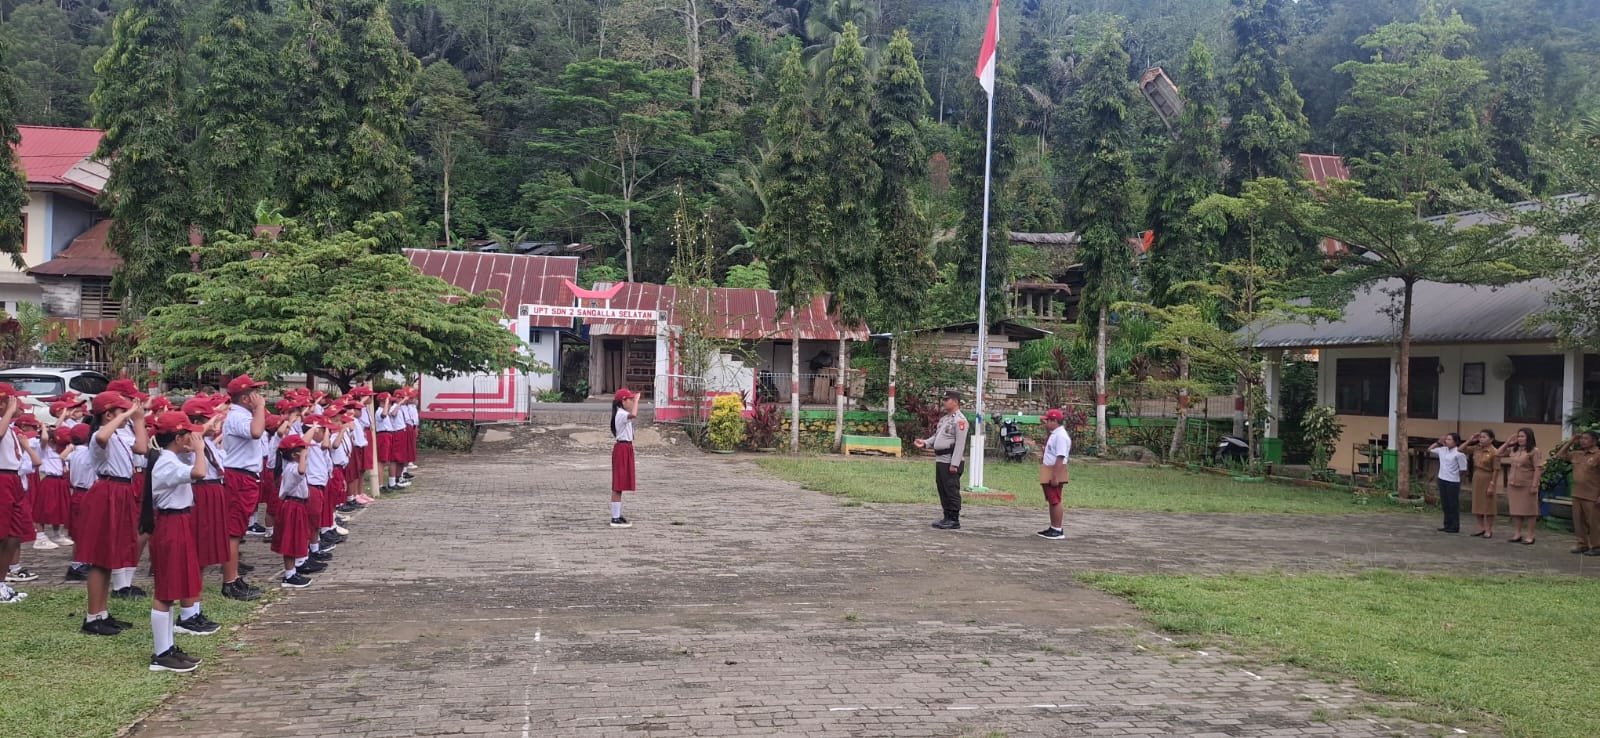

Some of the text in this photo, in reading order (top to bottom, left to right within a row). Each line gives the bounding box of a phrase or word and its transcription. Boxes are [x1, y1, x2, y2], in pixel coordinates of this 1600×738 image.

[533, 306, 549, 314] UPT
[551, 307, 566, 315] SDN
[618, 310, 652, 318] SELATAN
